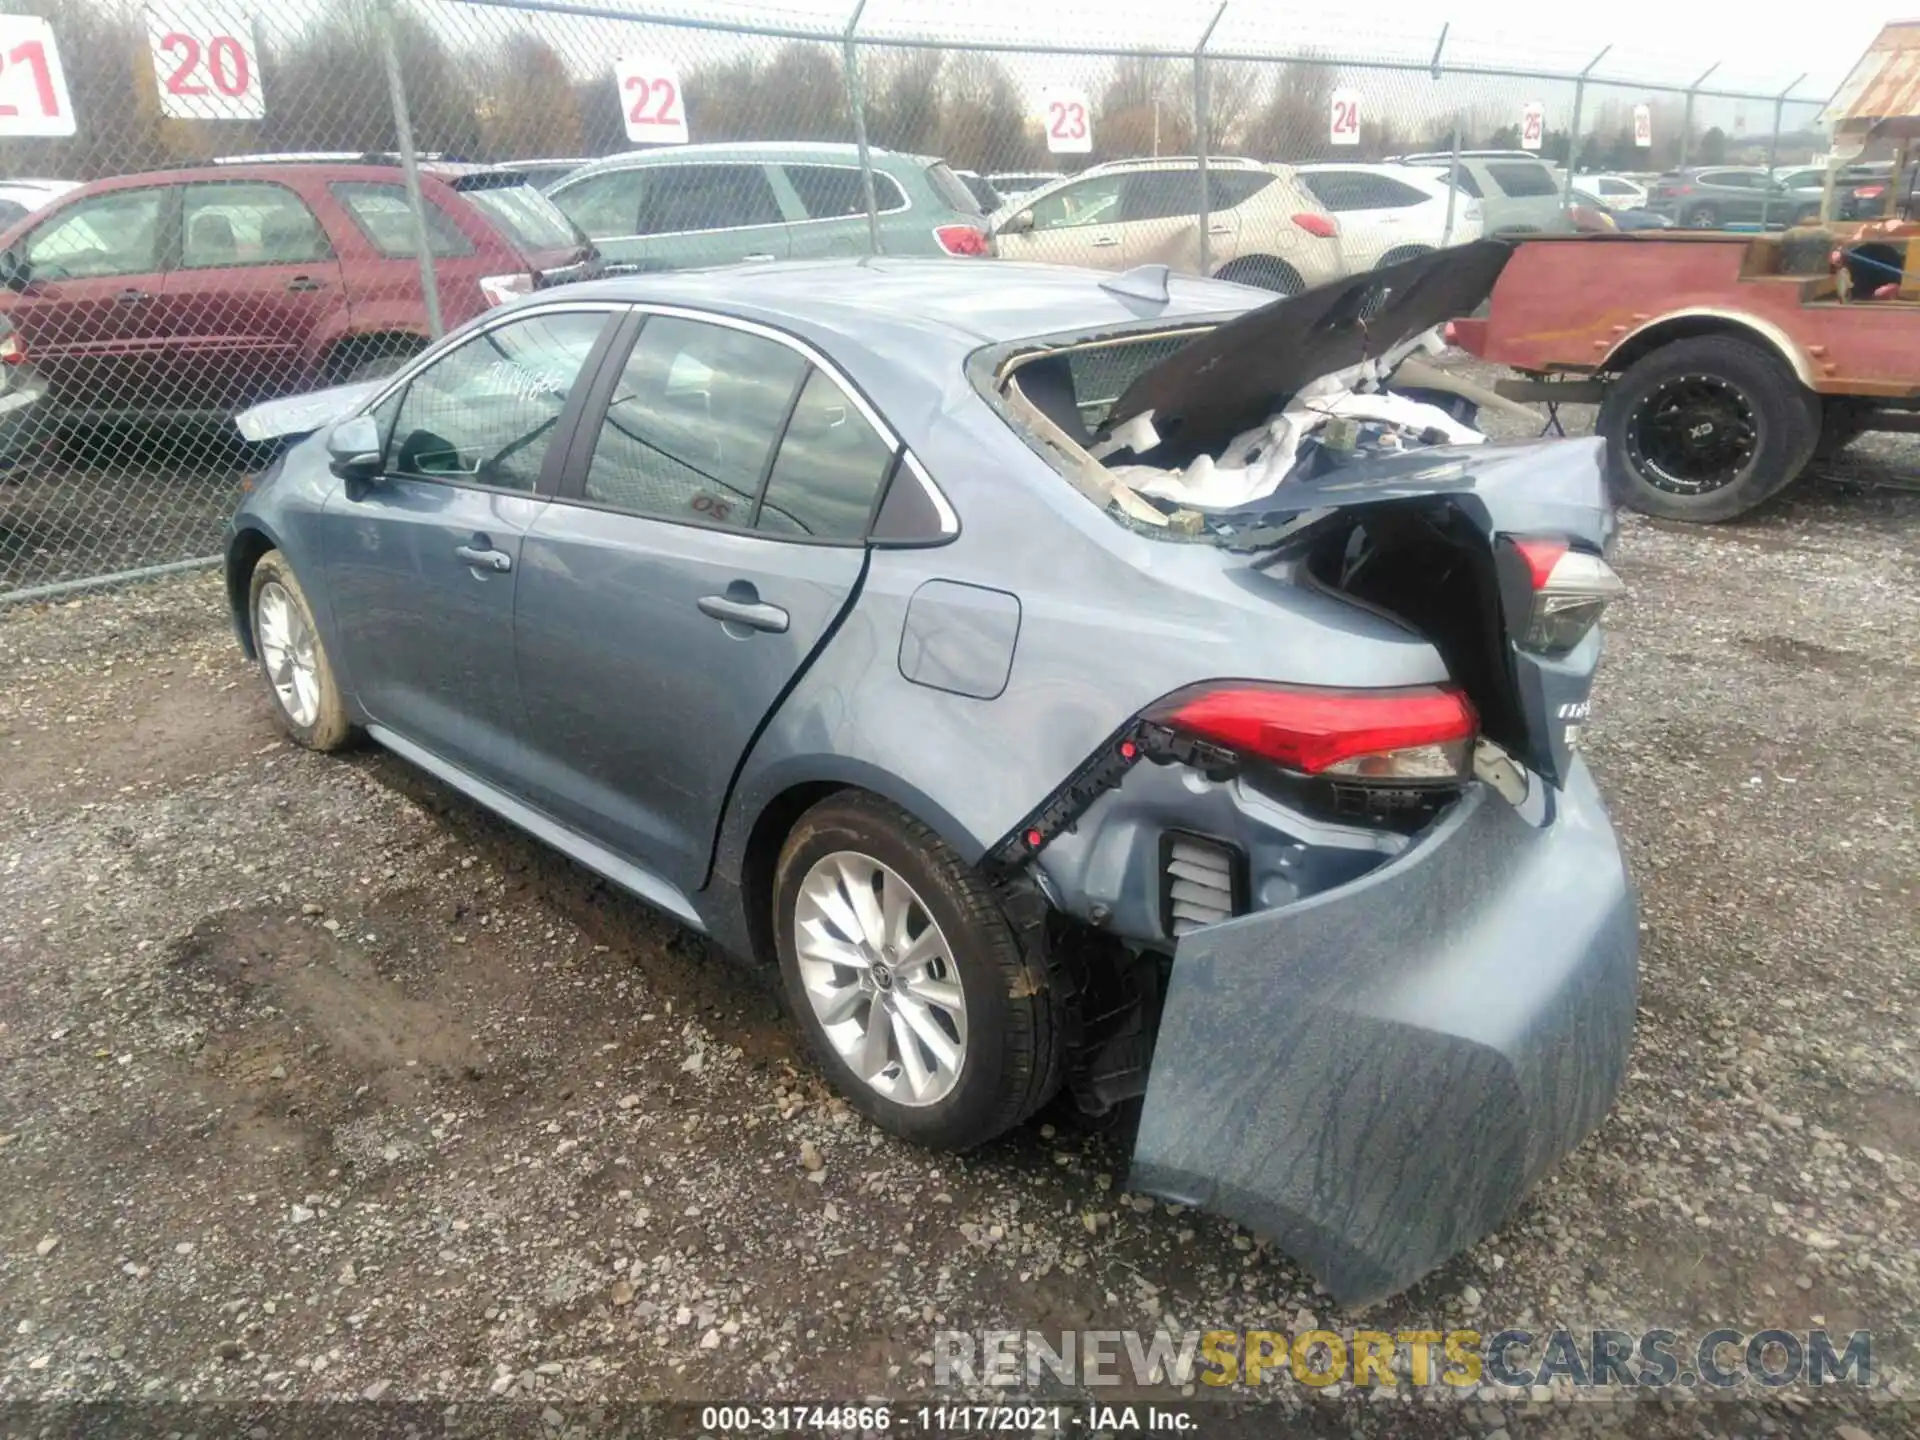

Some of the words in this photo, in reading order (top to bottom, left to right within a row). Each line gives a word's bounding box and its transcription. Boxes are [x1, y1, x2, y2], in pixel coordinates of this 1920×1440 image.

[161, 32, 249, 97] 20
[625, 76, 681, 126] 22
[1050, 101, 1086, 140] 23
[1333, 101, 1358, 134] 24
